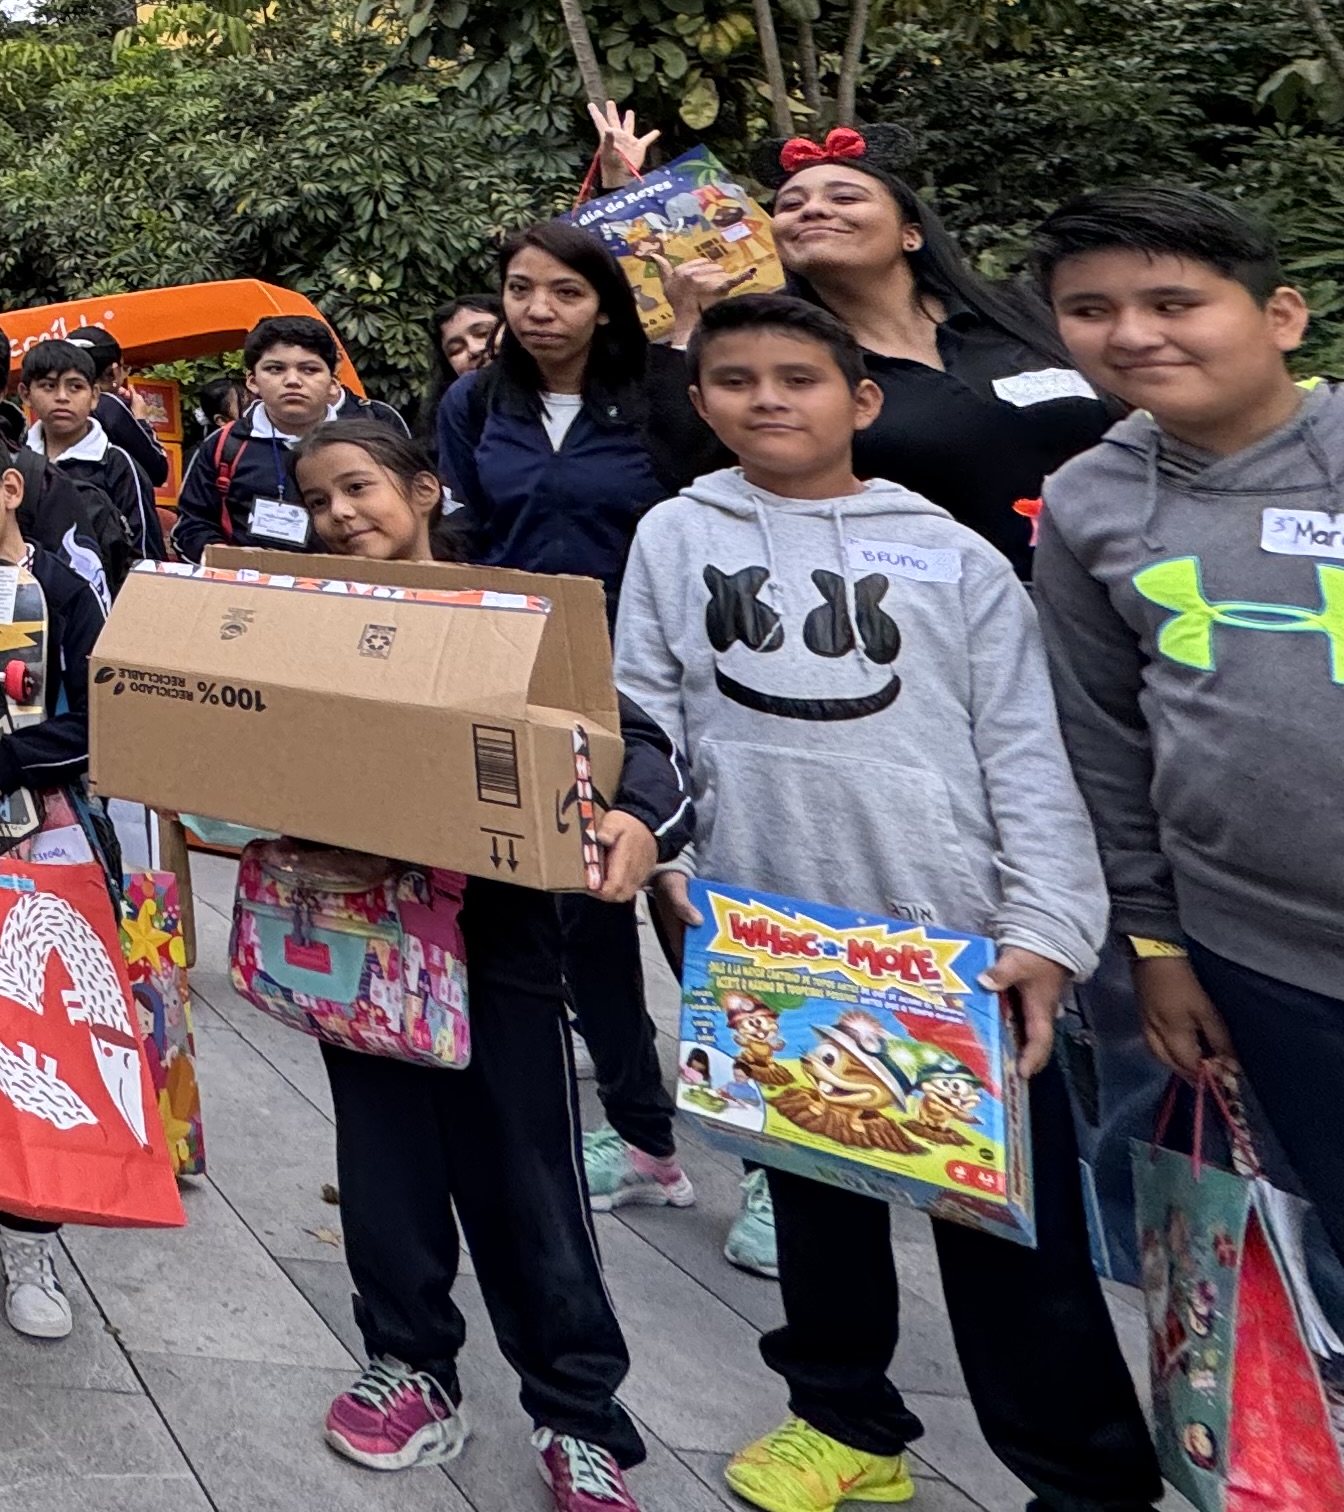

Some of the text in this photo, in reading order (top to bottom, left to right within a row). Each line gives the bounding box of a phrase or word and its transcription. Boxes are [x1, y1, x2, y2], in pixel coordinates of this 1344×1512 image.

[624, 180, 673, 204] Reyes
[1292, 520, 1344, 548] Mar
[118, 667, 186, 688] RECICLABLE
[128, 681, 194, 702] RECICLADO
[196, 681, 268, 713] 100%
